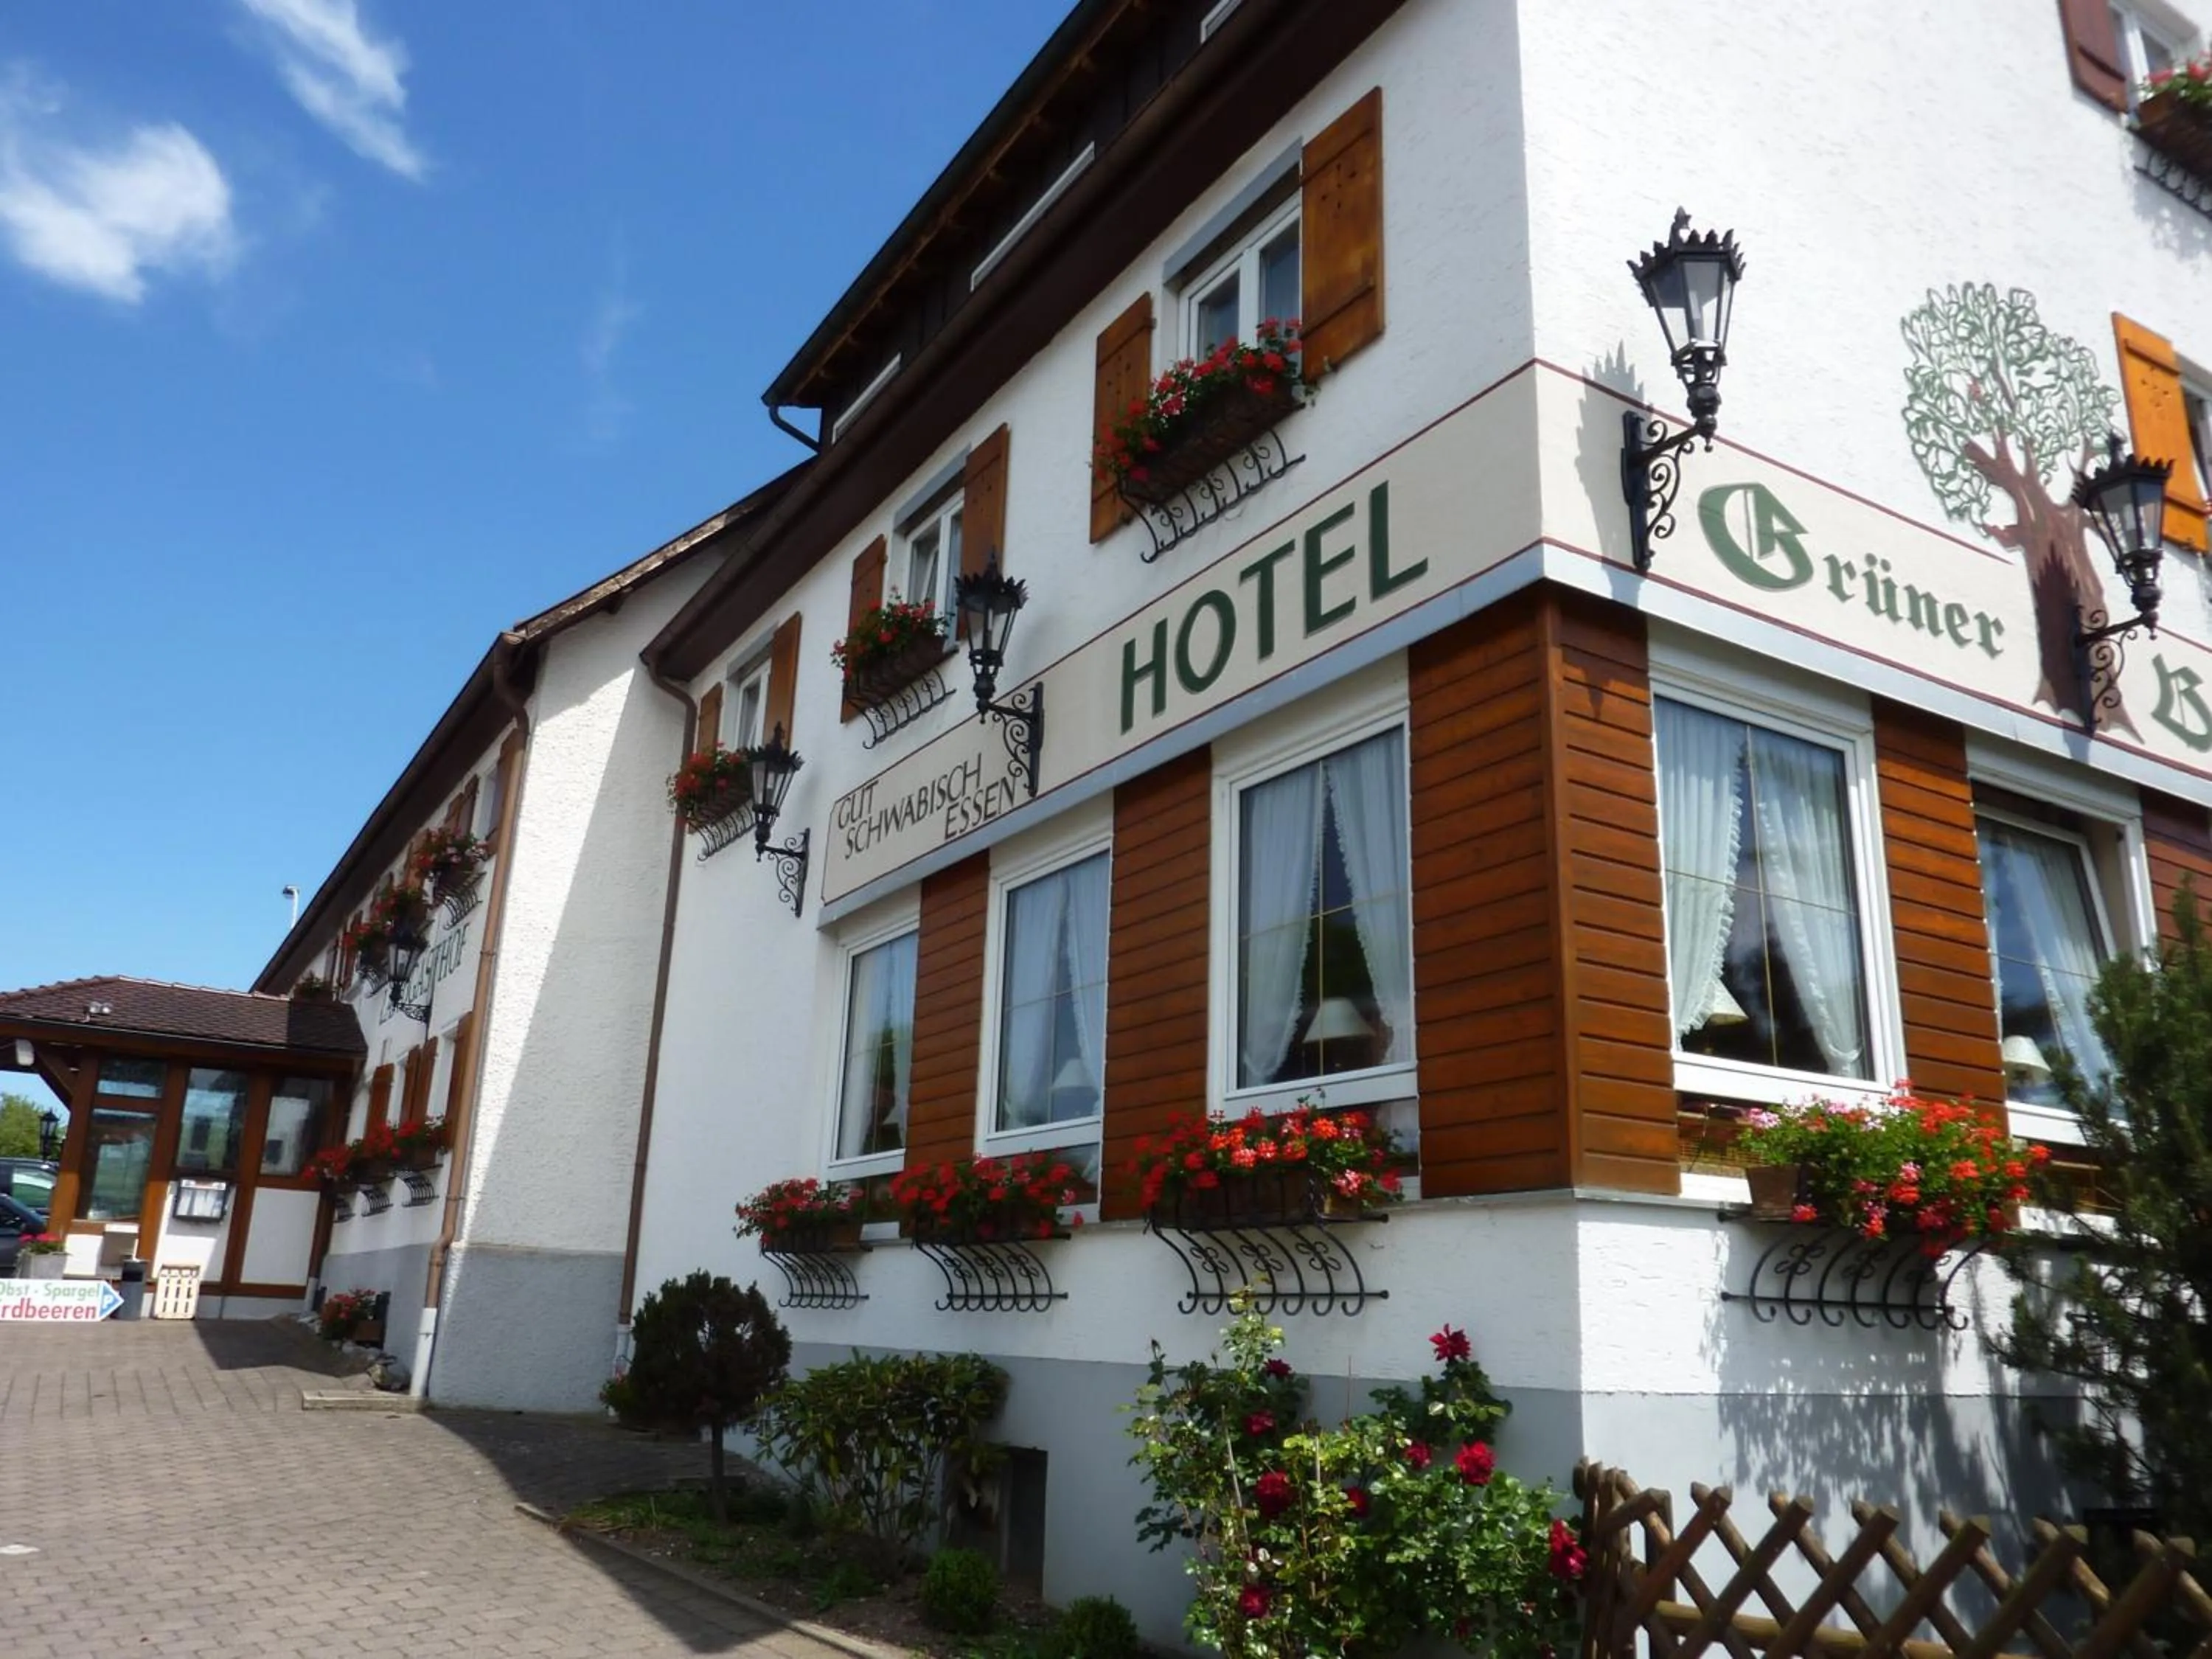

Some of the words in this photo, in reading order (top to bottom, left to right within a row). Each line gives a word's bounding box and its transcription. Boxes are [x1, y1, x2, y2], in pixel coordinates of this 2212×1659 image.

[1697, 482, 2005, 659] Grüner
[1121, 480, 1428, 735] HOTEL
[838, 780, 881, 830] GUT
[945, 775, 1016, 839] ESSEN
[0, 1298, 97, 1319] rdbeeren
[44, 1282, 100, 1301] Spargel
